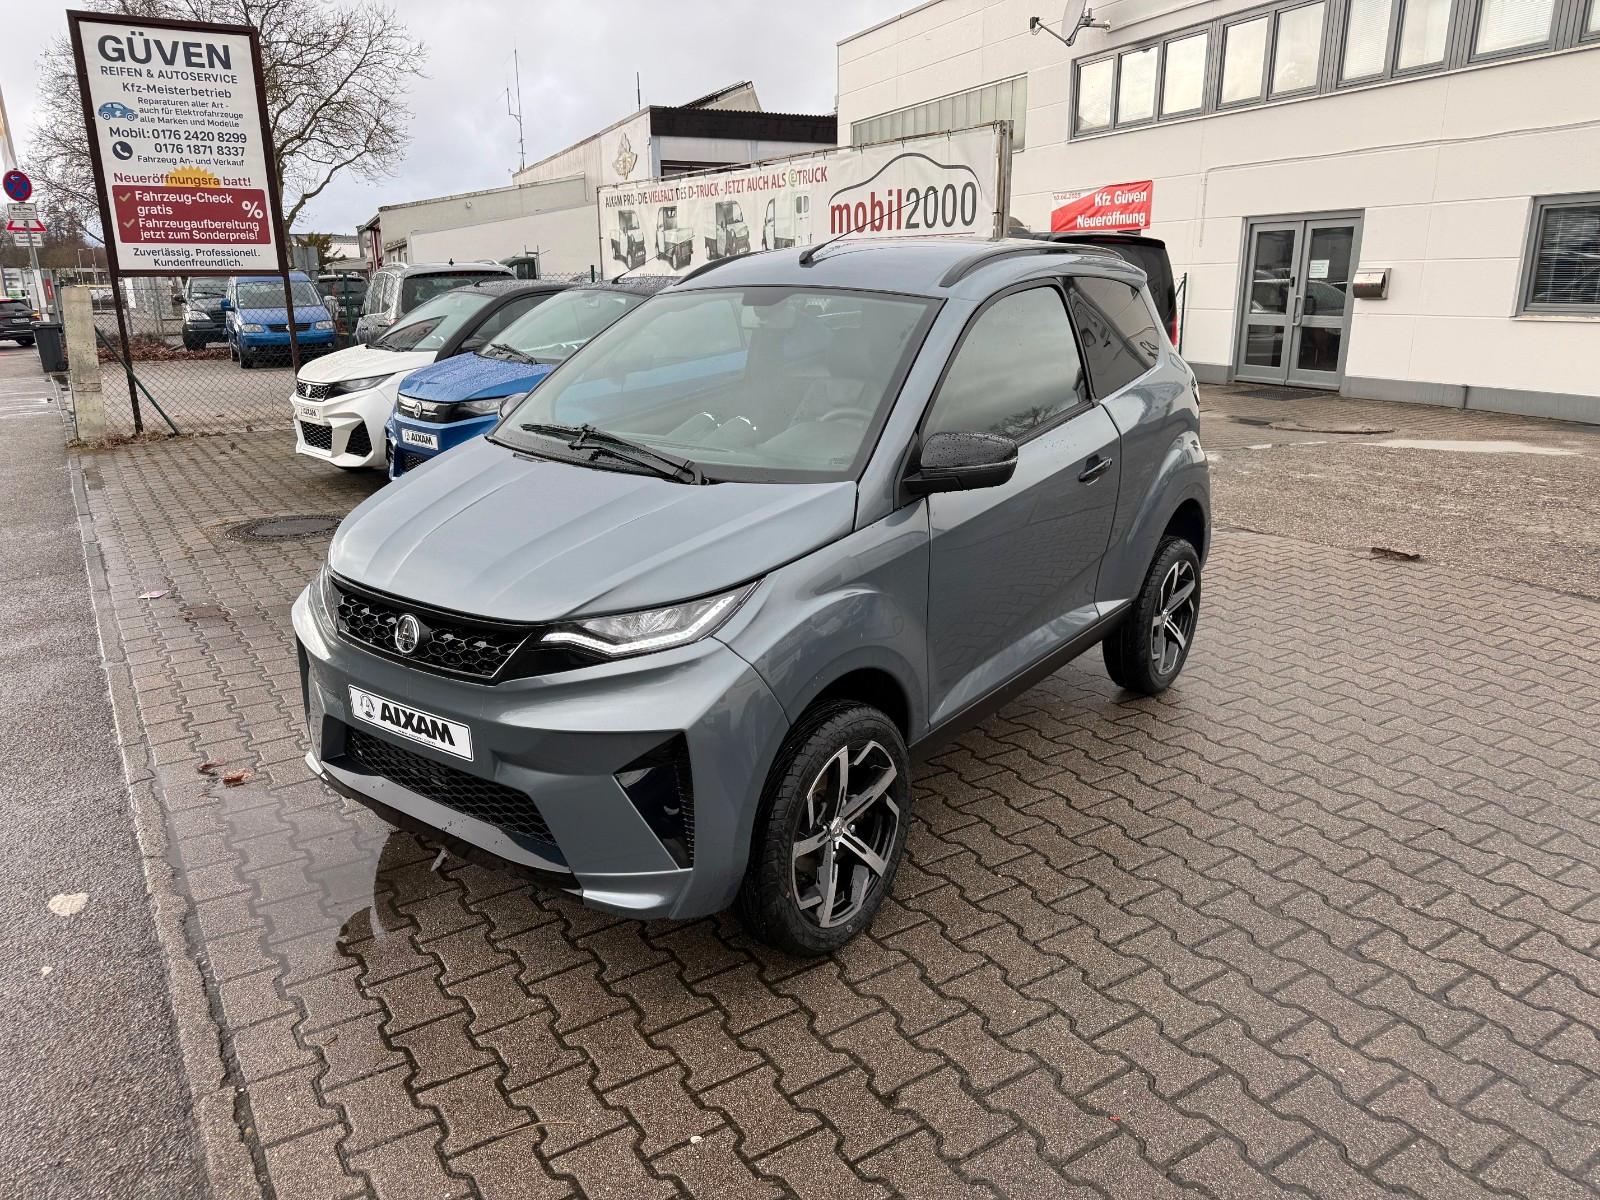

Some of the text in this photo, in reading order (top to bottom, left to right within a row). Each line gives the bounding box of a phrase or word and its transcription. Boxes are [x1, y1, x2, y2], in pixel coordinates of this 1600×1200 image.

[98, 31, 232, 70] GÜVEN
[100, 66, 238, 84] REIFEN & AUTOSERVICE
[122, 82, 232, 98] Kfz-Meisterbetrieb
[137, 97, 189, 107] Reparaturen
[175, 108, 243, 120] Elektrofahrzeuge
[157, 117, 188, 125] Marken
[207, 119, 239, 128] Modelle
[109, 127, 247, 143] Mobil: 0176 2420 8299
[154, 143, 245, 157] 0176 1871 8337
[137, 155, 177, 166] Fahrzeug
[623, 193, 634, 206] PRO
[638, 190, 648, 204] DIE
[648, 188, 674, 203] VIELFALT
[676, 186, 687, 200] DES
[688, 182, 718, 198] D-TRUCK
[724, 178, 744, 195] JETZT
[747, 175, 768, 192] AUCH
[771, 172, 786, 188] ALS
[135, 191, 233, 203] Fahrzeug-Check
[1095, 192, 1111, 206] Kfz
[1114, 191, 1147, 204] Güven
[137, 204, 173, 216] gratis
[242, 201, 263, 219] %
[830, 182, 977, 235] mobil2000
[139, 218, 259, 232] Fahrzeugaufbereitung
[1076, 212, 1145, 228] Neueröffnung
[140, 230, 258, 241] jetzt zum Sonderpreis!
[133, 248, 260, 258] Zuverlässig. Professionell.
[154, 258, 243, 268] Kundenfreundlich.
[304, 407, 317, 417] AIXAM
[410, 432, 432, 445] AIXAM
[381, 703, 455, 746] AIXAM
